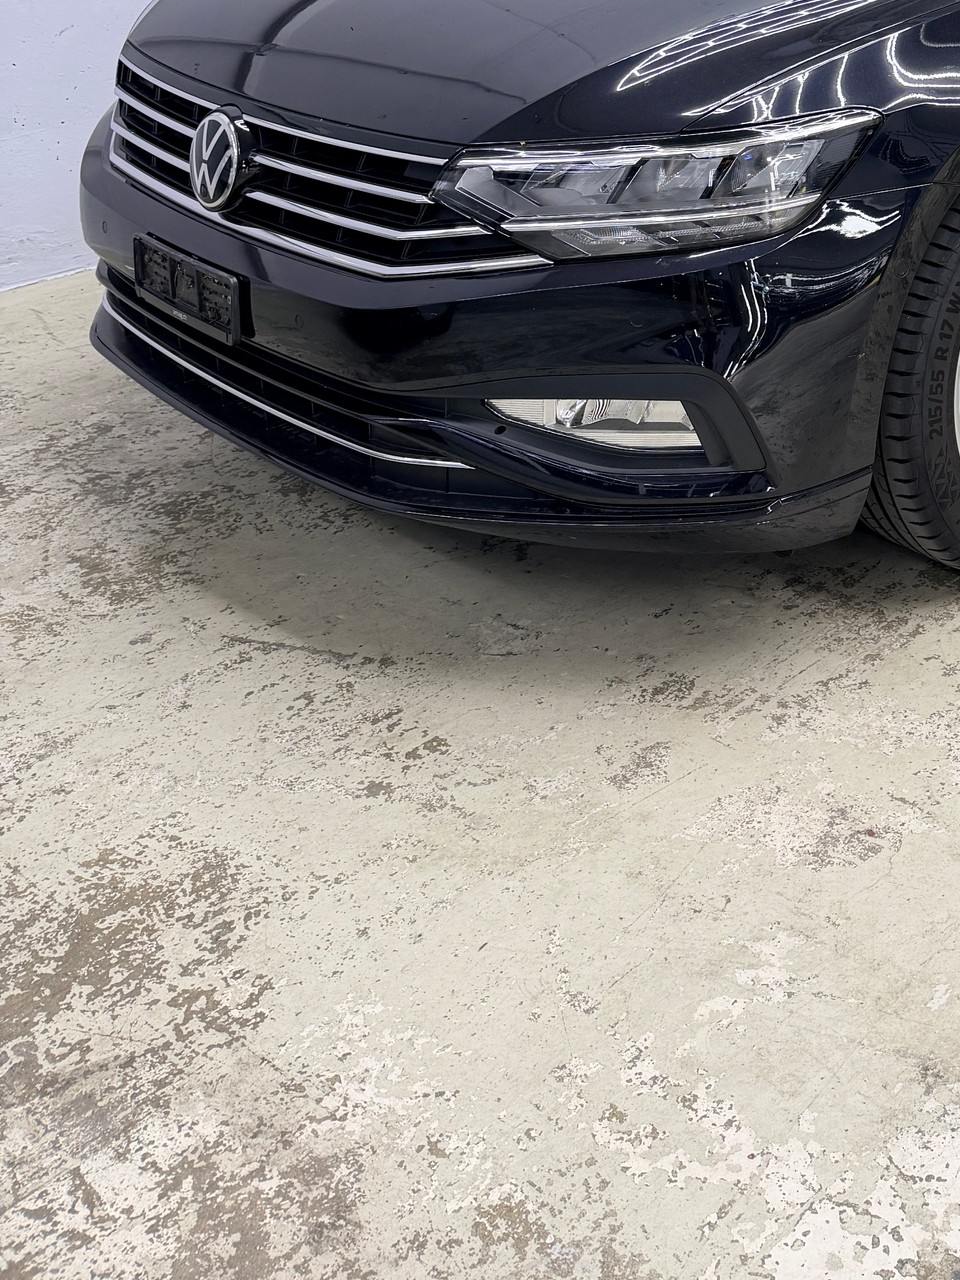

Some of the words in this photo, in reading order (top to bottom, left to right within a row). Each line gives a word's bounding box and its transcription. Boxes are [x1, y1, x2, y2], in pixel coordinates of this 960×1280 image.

[938, 318, 955, 341] 17
[933, 345, 950, 361] R
[928, 369, 945, 441] 215/55
